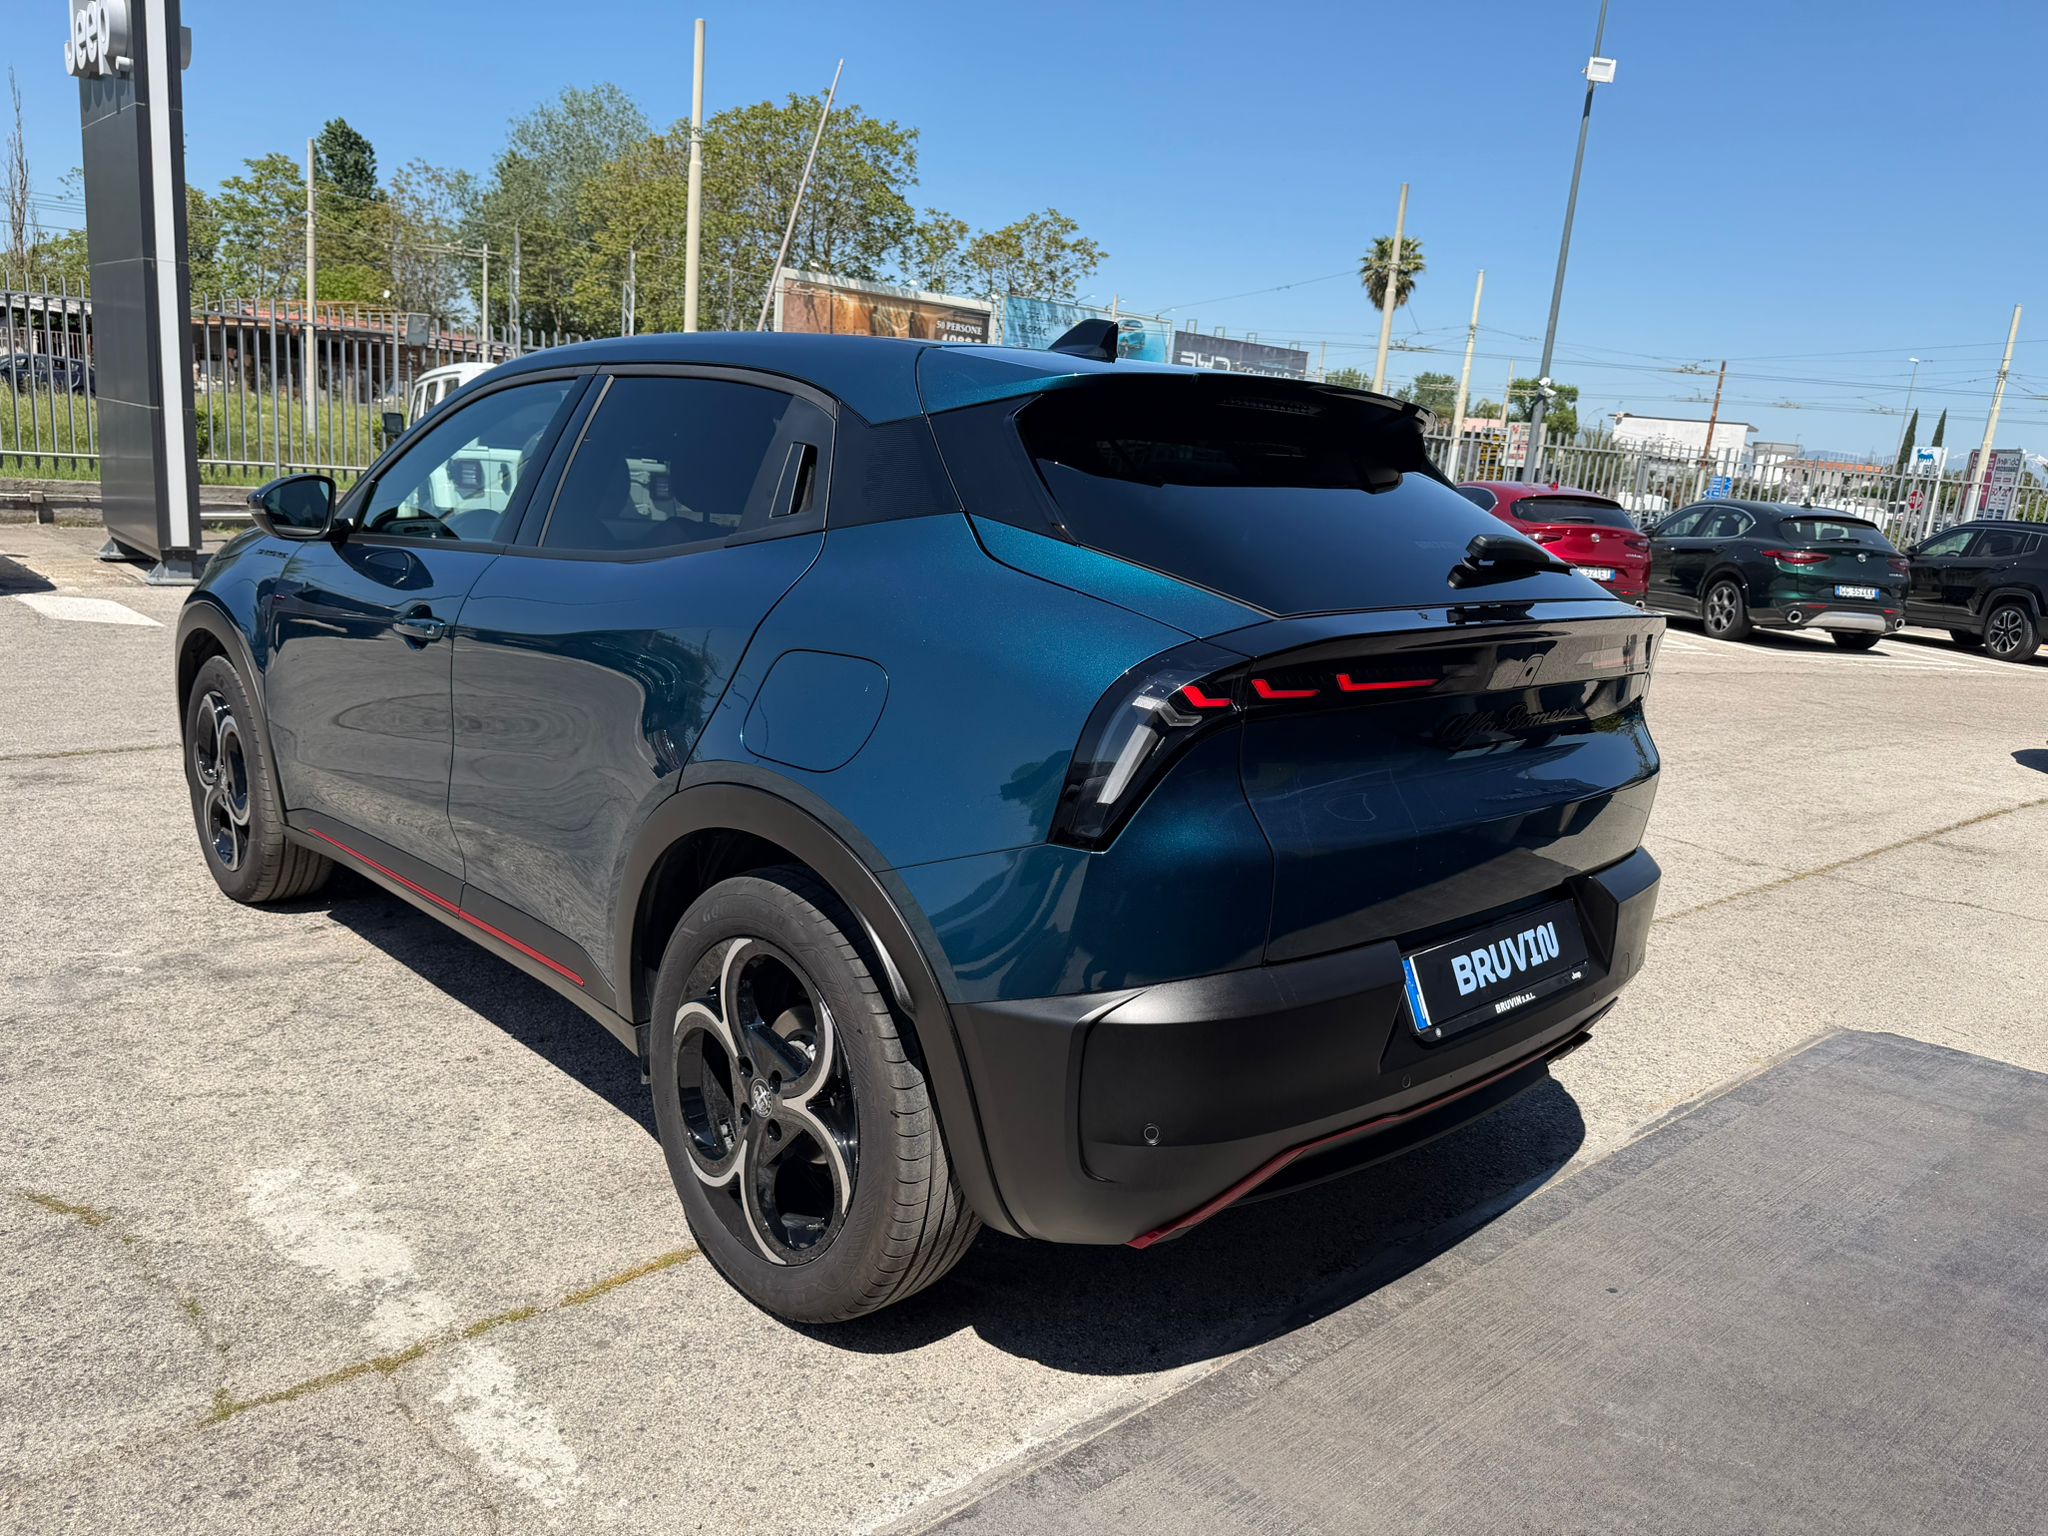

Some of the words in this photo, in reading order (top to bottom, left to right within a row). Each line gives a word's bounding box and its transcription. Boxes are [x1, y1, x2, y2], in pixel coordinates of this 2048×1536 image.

[64, 0, 116, 76] Jeep
[936, 320, 945, 329] 50
[946, 321, 983, 335] PERSONE
[1501, 703, 1574, 730] Romeo
[1451, 921, 1560, 996] BRUVIN
[1495, 994, 1522, 1014] BRUVIN
